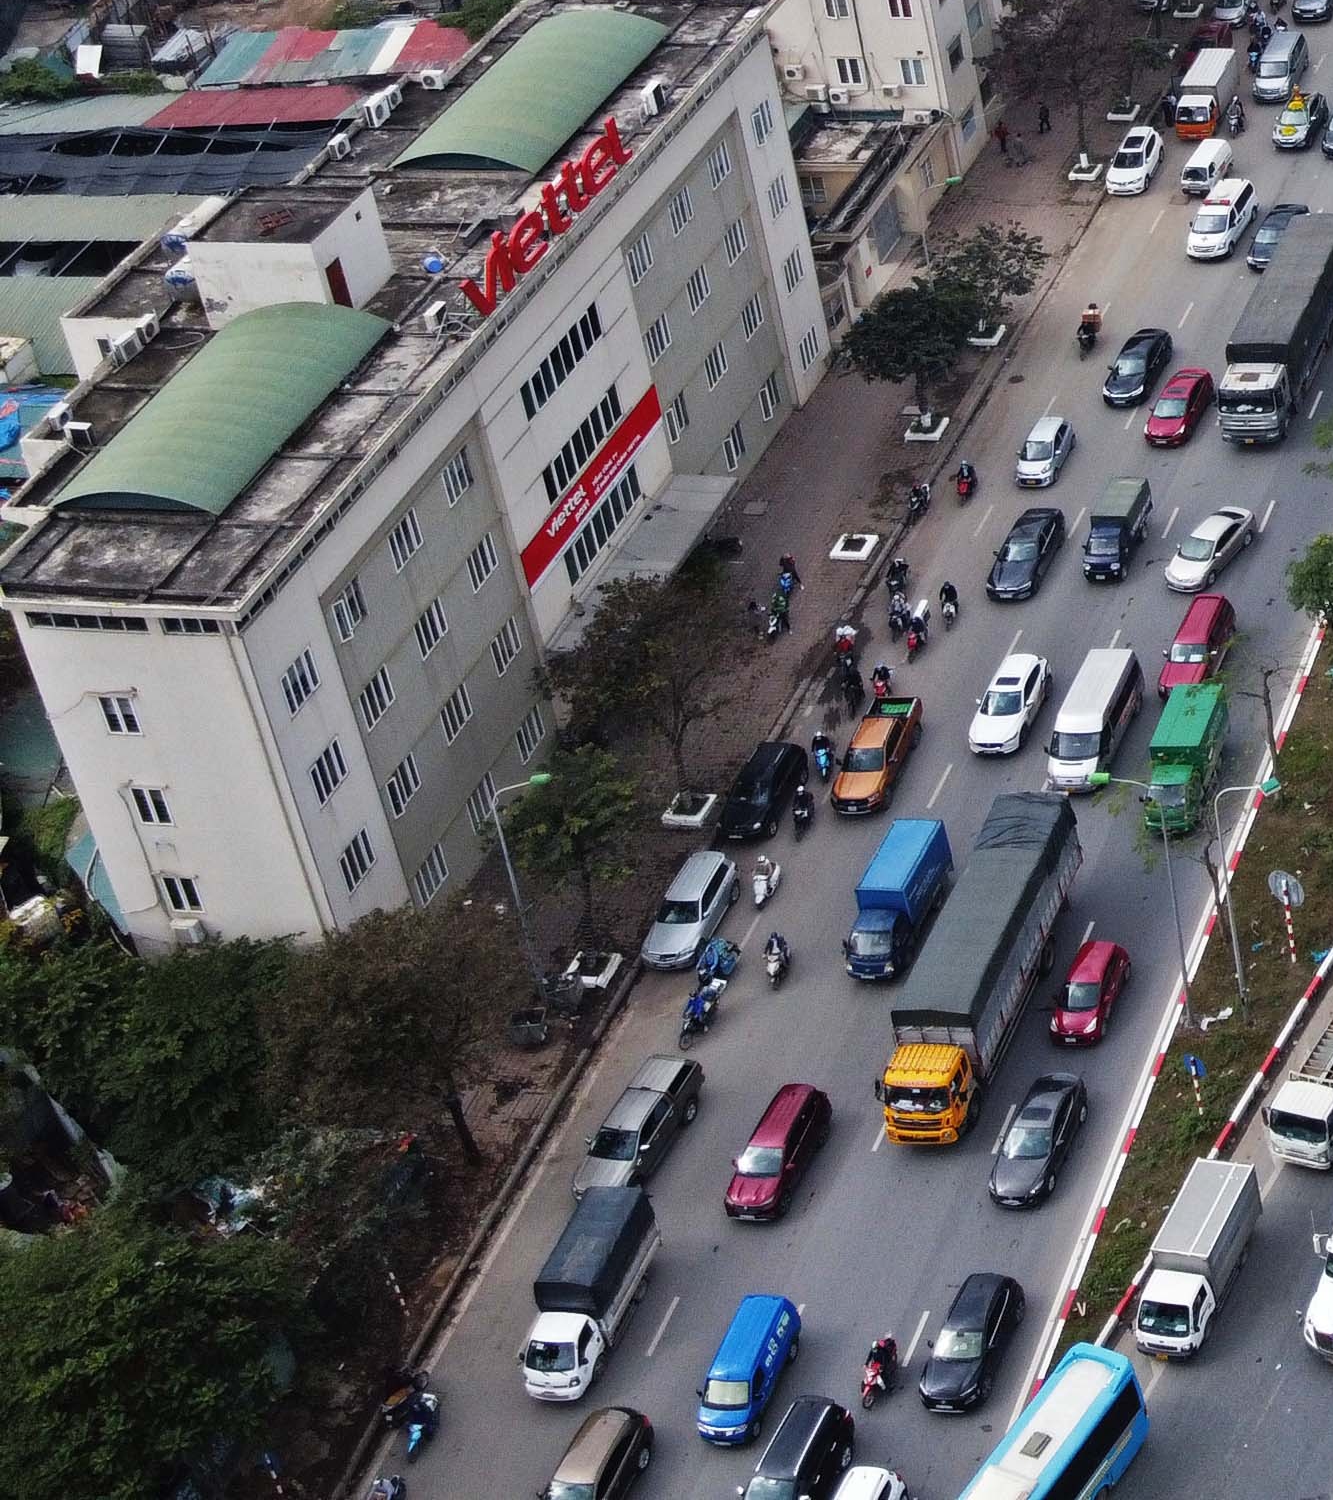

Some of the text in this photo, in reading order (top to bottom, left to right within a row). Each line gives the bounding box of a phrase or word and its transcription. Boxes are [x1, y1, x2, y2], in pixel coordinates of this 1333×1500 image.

[458, 116, 634, 318] viettel
[546, 484, 588, 538] viettel
[574, 498, 591, 523] post
